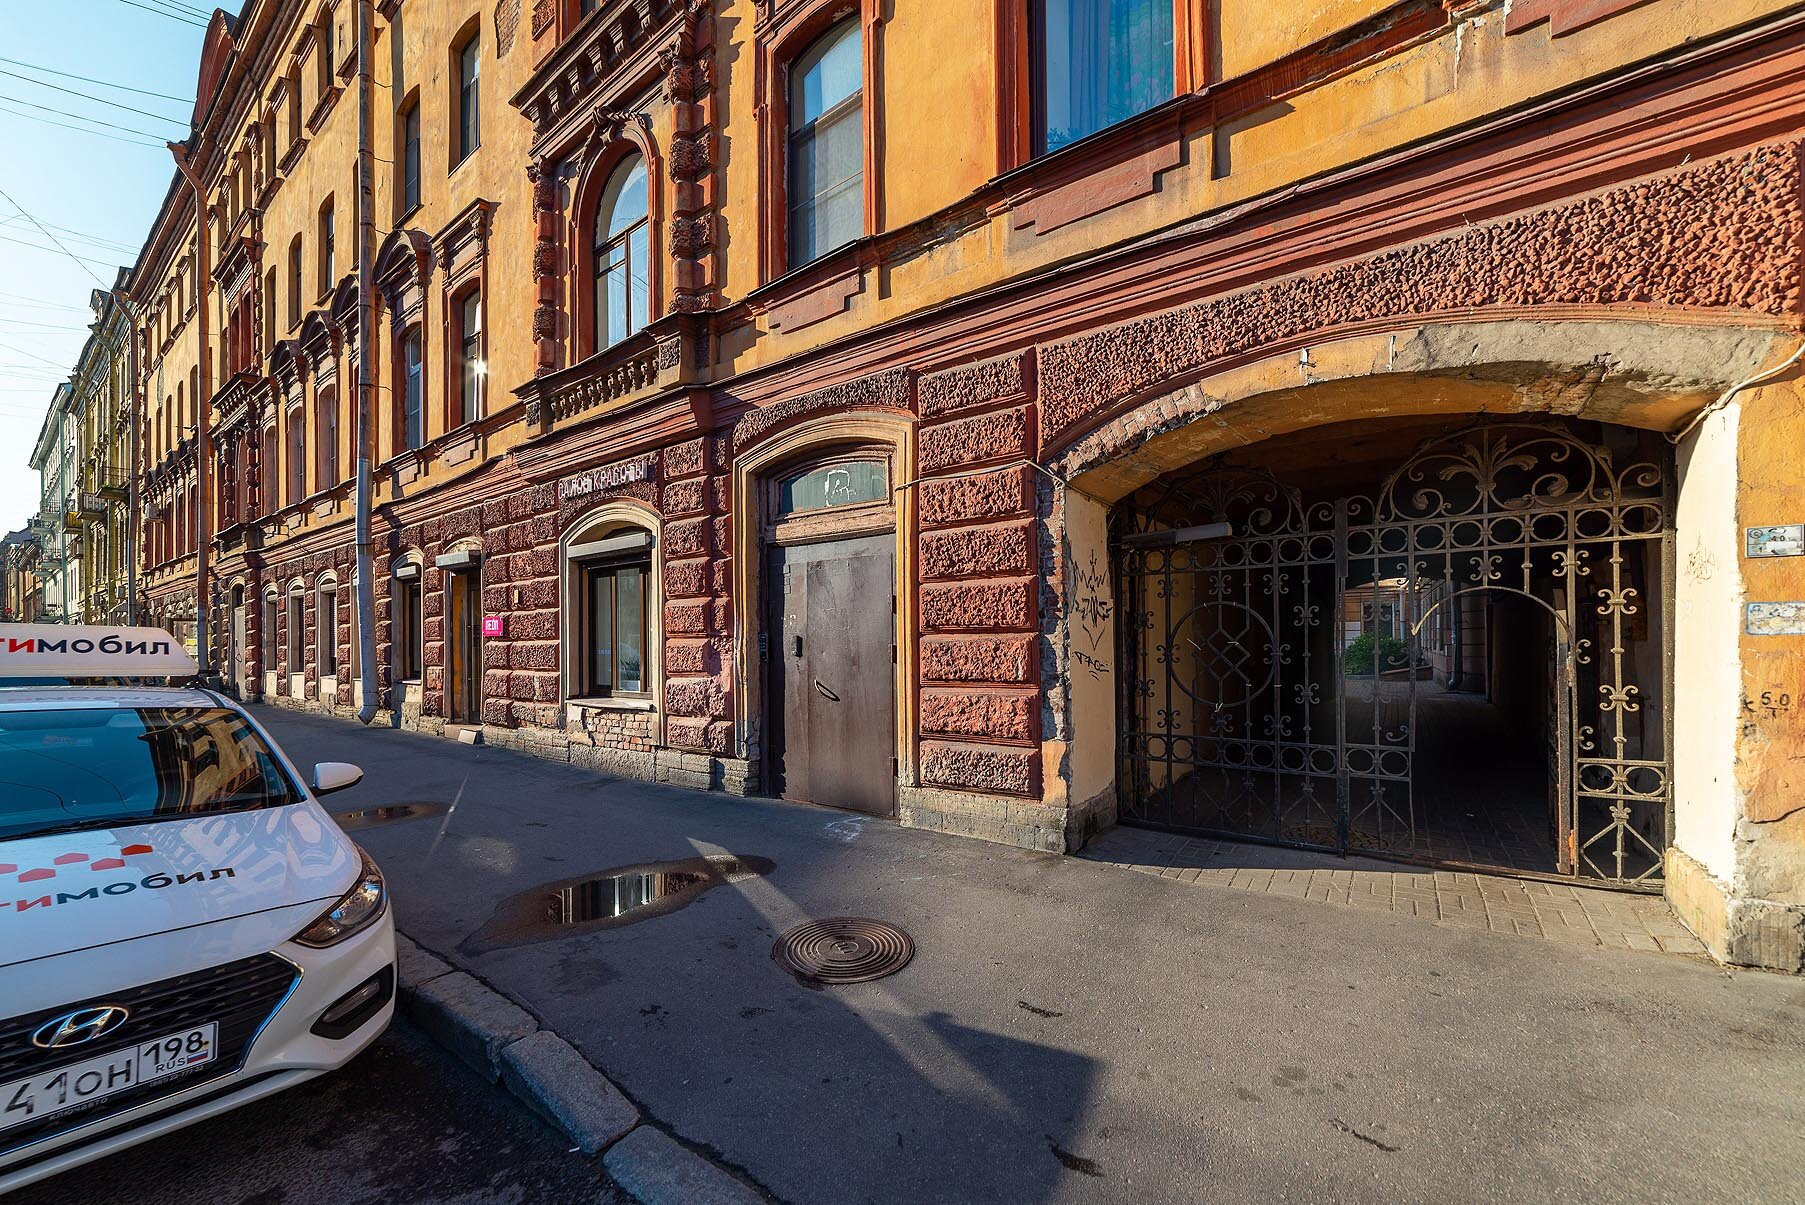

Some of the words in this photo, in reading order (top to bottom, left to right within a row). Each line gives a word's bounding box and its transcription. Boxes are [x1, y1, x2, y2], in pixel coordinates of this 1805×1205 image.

[558, 475, 592, 500] САЛОН
[594, 460, 648, 492] КРАСОТЫ
[0, 634, 170, 655] имобил
[144, 1031, 204, 1066] 198
[155, 1057, 186, 1073] RUS
